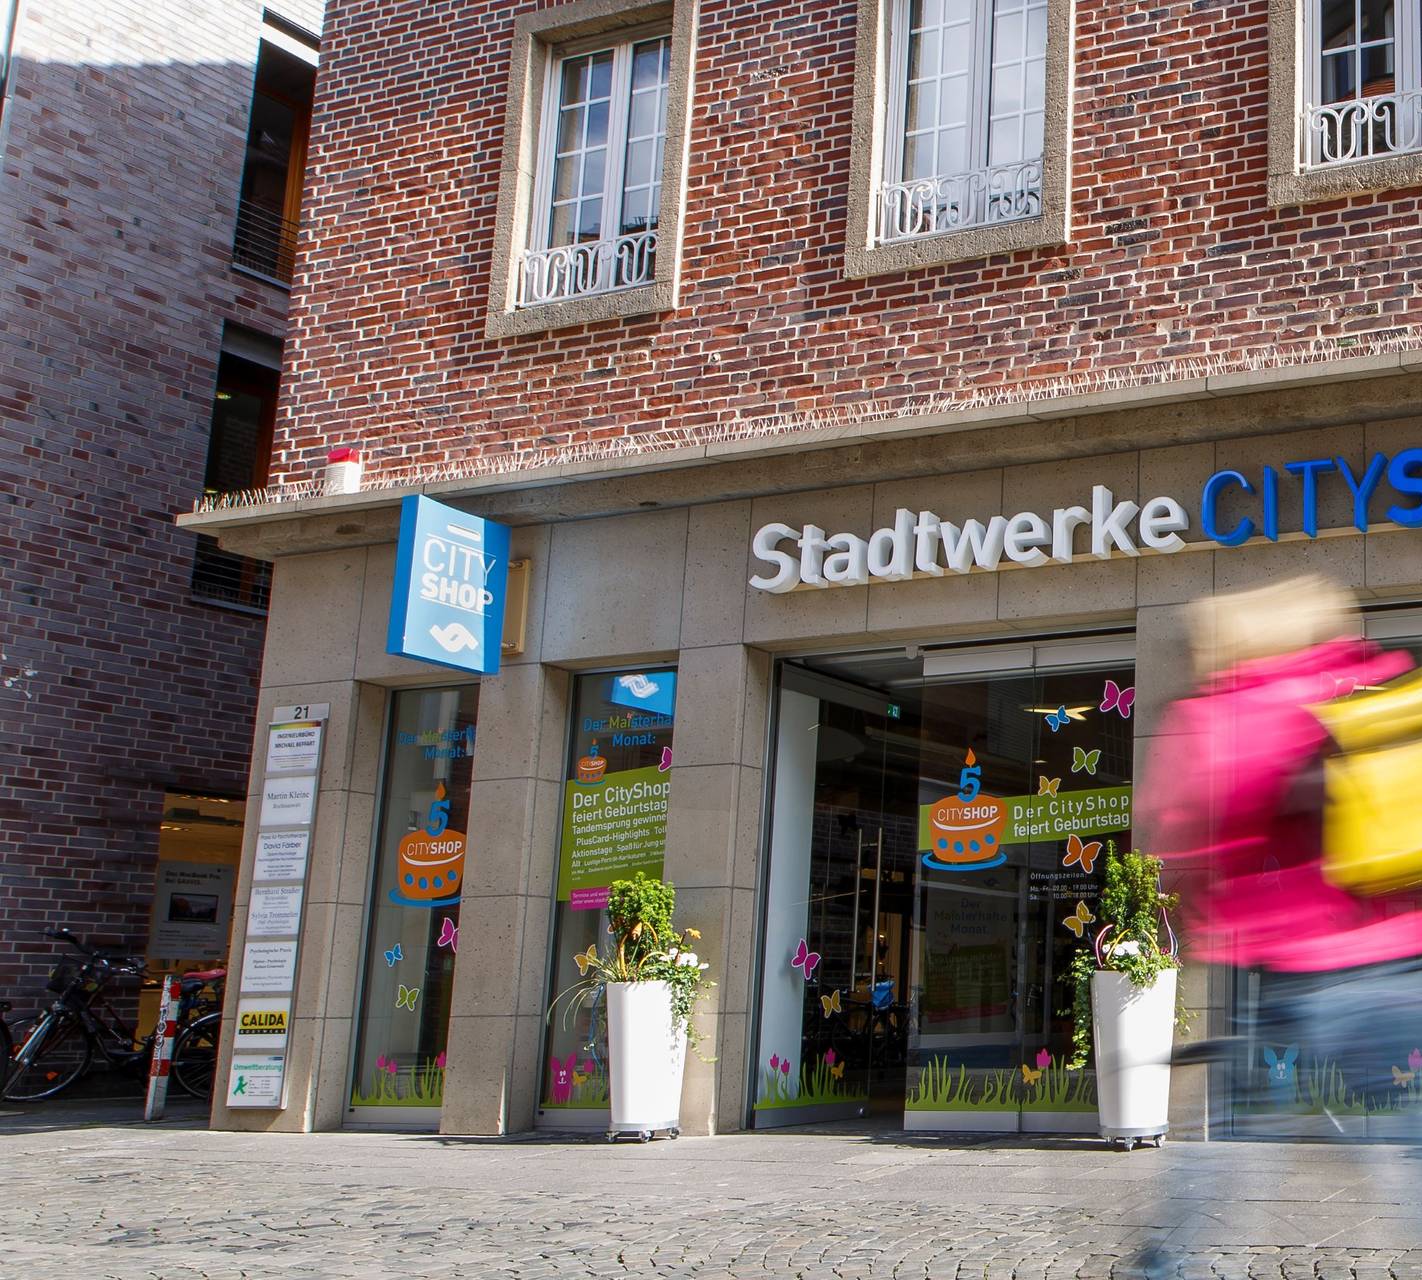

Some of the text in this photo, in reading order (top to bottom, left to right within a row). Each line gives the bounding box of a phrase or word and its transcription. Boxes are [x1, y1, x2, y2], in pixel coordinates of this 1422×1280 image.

[749, 484, 1190, 594] Stadtwerke
[423, 537, 497, 585] CITY
[420, 573, 494, 613] SHOP
[294, 705, 310, 720] 21
[583, 713, 672, 732] Der Maisterha
[612, 733, 656, 747] Monat:
[590, 745, 599, 758] 5
[957, 765, 982, 803] 5
[268, 792, 287, 801] Martin
[573, 782, 671, 809] Der CityShop
[425, 799, 450, 837] 5
[572, 800, 667, 824] feiert Geburtstag
[937, 805, 998, 822] CITYSHOP
[1013, 795, 1130, 820] Der CityShop
[572, 813, 668, 836] Tandemsprung gewinne
[1013, 813, 1130, 837] feiert Geburtstag
[263, 841, 280, 850] David
[407, 841, 463, 856] CITYSHOP
[571, 845, 613, 860] Aktionstage
[241, 1013, 285, 1027] CALIDA
